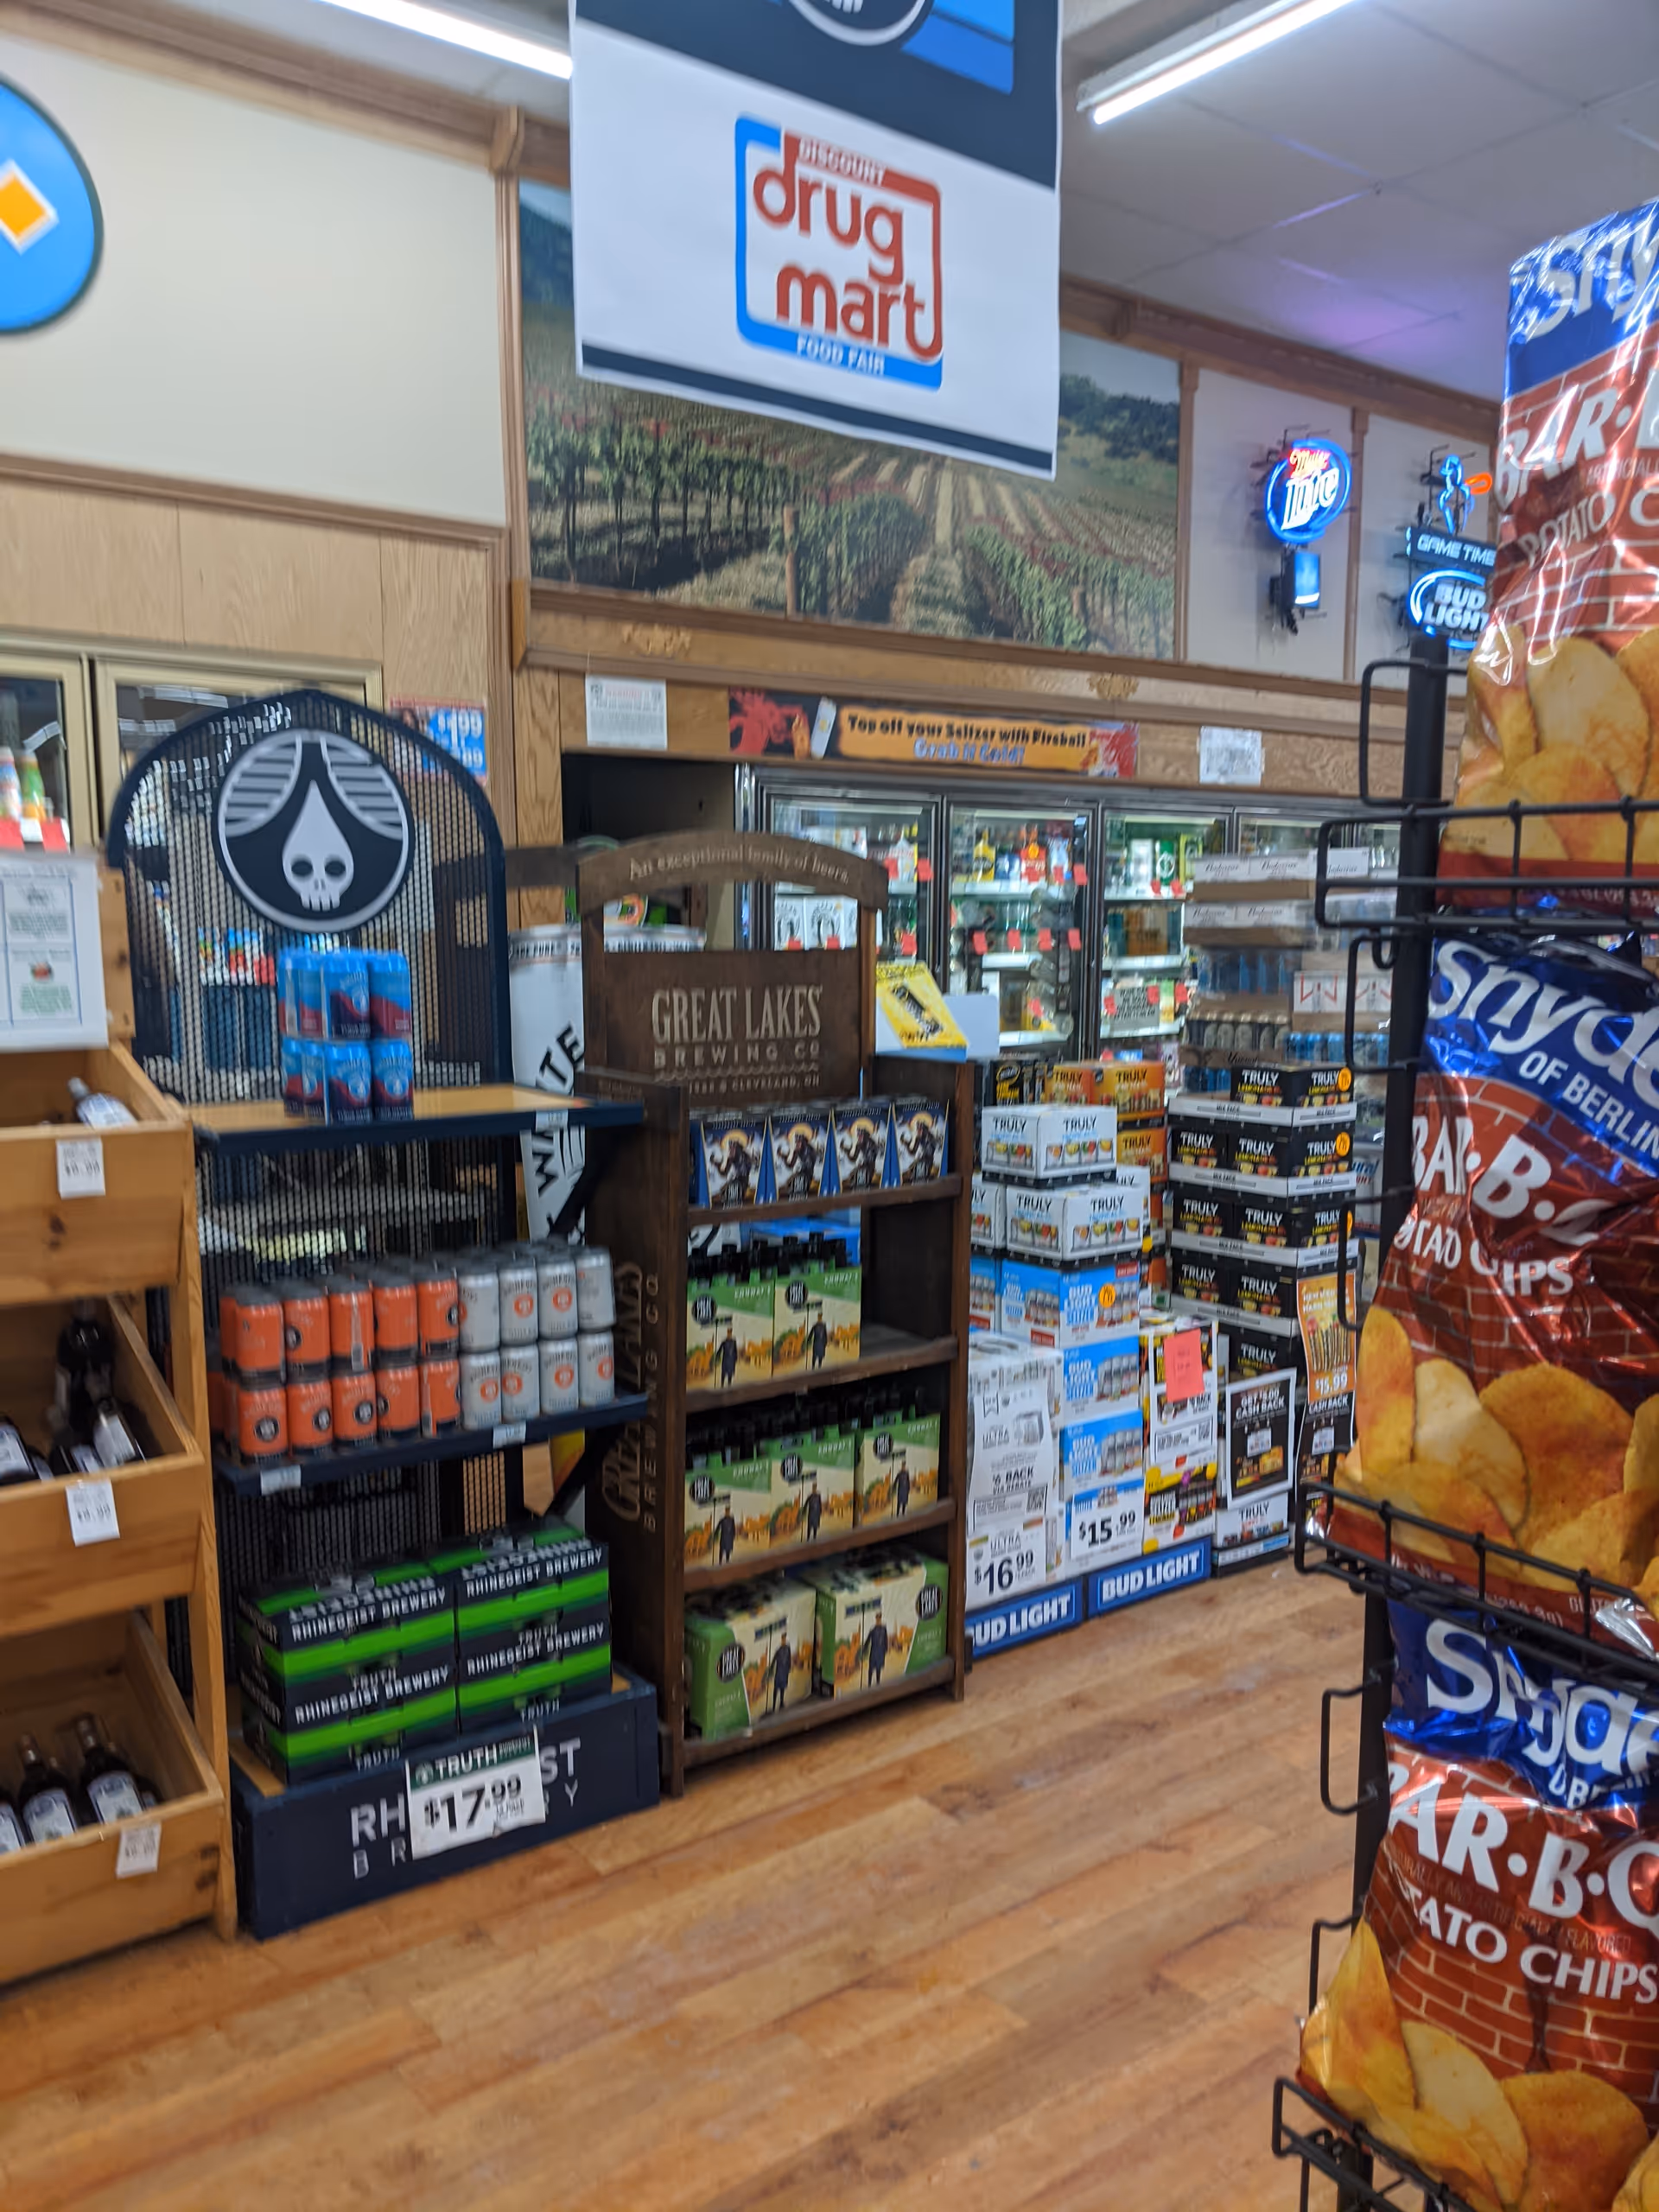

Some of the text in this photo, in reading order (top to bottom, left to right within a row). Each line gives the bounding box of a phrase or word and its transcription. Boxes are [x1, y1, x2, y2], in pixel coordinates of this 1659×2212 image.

[799, 139, 884, 185] DISCOUNT
[753, 160, 903, 285] drug
[777, 263, 942, 360] mart
[797, 336, 885, 374] FOOD FAIR
[1518, 492, 1616, 569] POTATO
[1417, 534, 1497, 566] GAME TIME
[1435, 583, 1486, 610] BUD
[1426, 604, 1490, 632] LIGHT
[848, 715, 1087, 748] Top off your Seltzer with Fireball
[914, 736, 959, 760] Grab
[980, 741, 1026, 766] Cold!
[630, 857, 653, 881] An
[658, 844, 744, 873] exceptional
[746, 844, 786, 870] family
[794, 854, 809, 868] of
[652, 984, 823, 1044] GREAT LAKES
[655, 1041, 820, 1069] BREWING CO
[1116, 1069, 1147, 1083] TRULY
[1242, 1069, 1280, 1086] TRULY
[1312, 1071, 1340, 1086] TRULY
[1519, 1051, 1659, 1156] OF BERLIN
[993, 1116, 1027, 1134] TRULY
[1063, 1116, 1097, 1132] TRULY
[1122, 1135, 1152, 1149] TRULY
[1180, 1132, 1214, 1147] TRULY
[1239, 1138, 1274, 1156] TRULY
[1307, 1141, 1337, 1156] TRULY
[1016, 1194, 1052, 1211] TRULY
[1090, 1196, 1124, 1211] TRULY
[1183, 1198, 1219, 1217] TRULY
[1245, 1208, 1283, 1226] TRULY
[1181, 1264, 1216, 1283] TRULY
[1068, 1284, 1093, 1298] BUD
[1241, 1275, 1277, 1295] TRULY
[1241, 1343, 1276, 1365] TRULY
[1068, 1360, 1092, 1375] BUD
[1065, 1371, 1097, 1389] LIGHT
[1315, 1372, 1348, 1396] $15.99
[1236, 1395, 1285, 1420] CASH BACK
[1241, 1394, 1258, 1408] GET
[1328, 1394, 1349, 1409] BACK
[1072, 1434, 1097, 1448] BUD
[1068, 1445, 1101, 1462] LIGHT
[1006, 1467, 1034, 1484] BACK
[1238, 1501, 1269, 1521] TRULY
[466, 1565, 540, 1598] RHINEGEIST
[546, 1548, 602, 1578] BREWERY
[1102, 1572, 1144, 1603] BUD
[1145, 1551, 1200, 1588] LIGHT
[291, 1604, 376, 1642] RHINEGEIST
[382, 1586, 446, 1618] BREWERY
[1009, 1595, 1071, 1637] LIGHT
[519, 1624, 557, 1645] TRUTH
[467, 1622, 604, 1675] RHINEGEIST BREWERY
[353, 1668, 397, 1690] TRUTH
[295, 1664, 449, 1725] RHINEGEIST BREWERY
[520, 1698, 560, 1722] TRUTH
[355, 1746, 400, 1771] TRUTH
[435, 1744, 498, 1780] TRUTH
[1520, 1944, 1658, 2004] CHIPS
